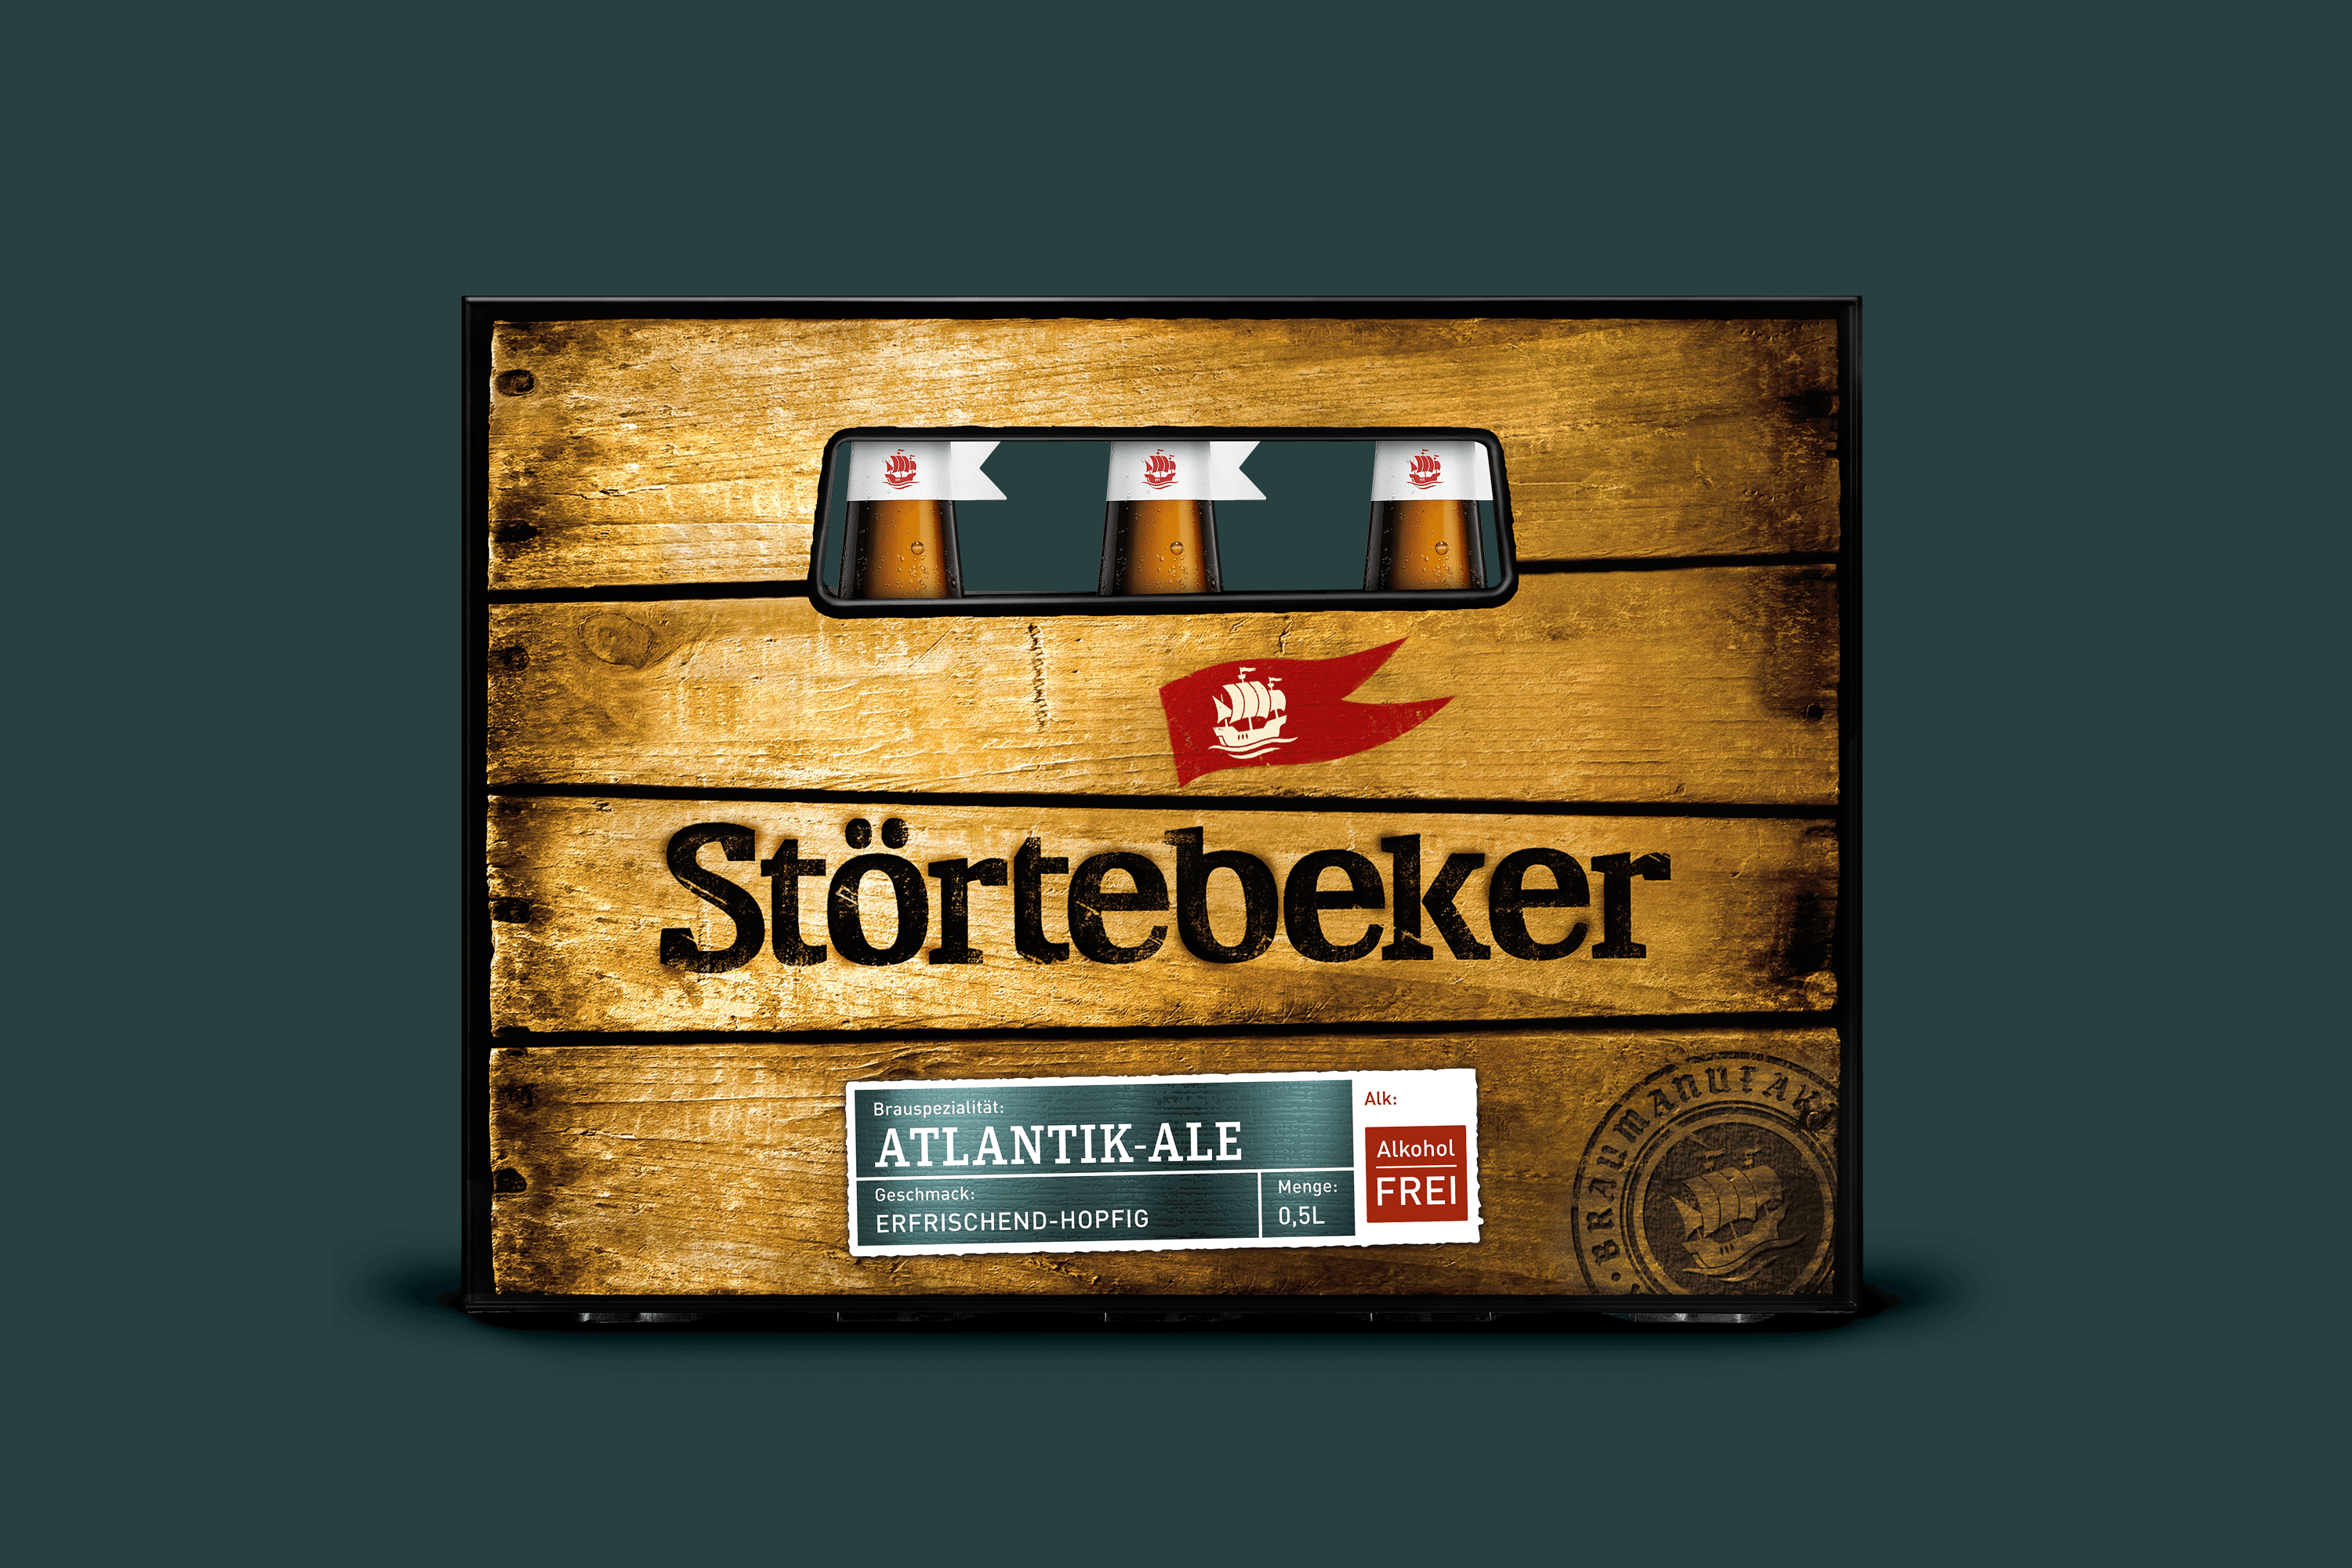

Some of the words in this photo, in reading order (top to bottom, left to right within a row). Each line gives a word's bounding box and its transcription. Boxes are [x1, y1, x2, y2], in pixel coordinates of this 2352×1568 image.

[660, 817, 1671, 972] Störtebeker
[1364, 1091, 1397, 1105] Alk:
[873, 1100, 1004, 1117] Brauspezialität:
[874, 1122, 1242, 1167] ATLANTIK-ALE
[1377, 1139, 1455, 1158] Alkohol
[875, 1186, 975, 1202] Geschmack:
[1278, 1179, 1338, 1196] Menge:
[1376, 1176, 1456, 1206] FREI
[877, 1209, 1149, 1233] ERFRISCHEND-HOPFIG
[1279, 1206, 1325, 1228] 0,5L
